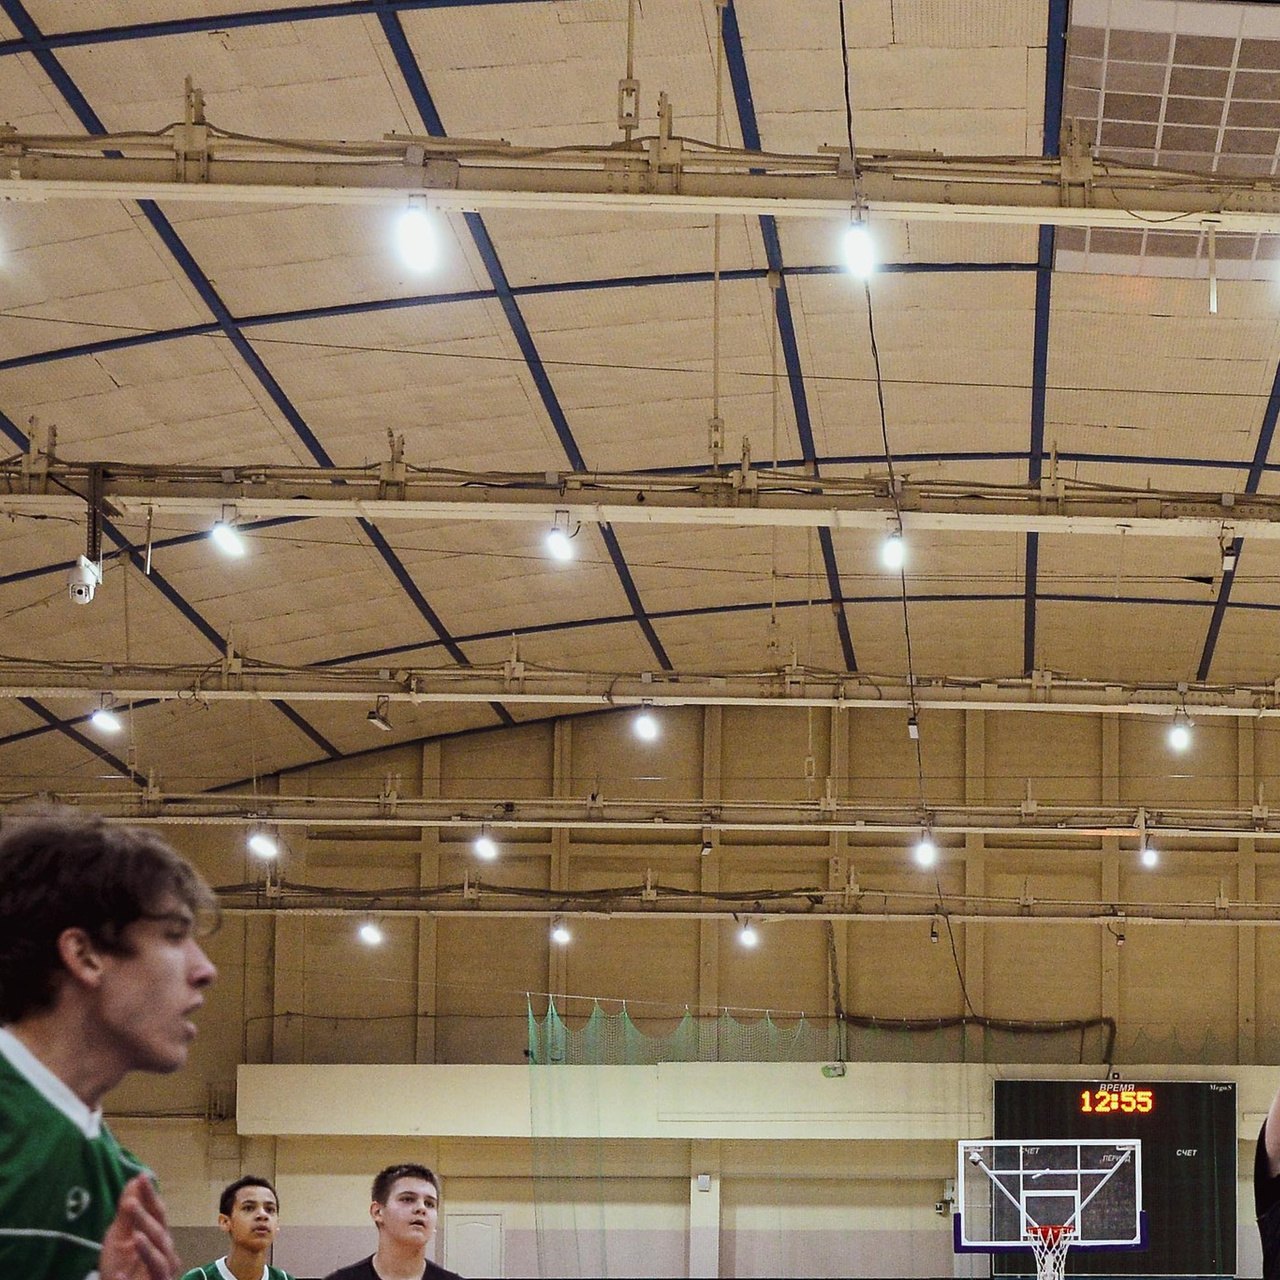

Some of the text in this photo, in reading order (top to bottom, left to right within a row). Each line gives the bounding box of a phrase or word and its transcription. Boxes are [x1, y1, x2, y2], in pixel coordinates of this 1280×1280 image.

[1099, 1083, 1135, 1092] ВРЕМЯ
[1081, 1090, 1153, 1112] 12:55
[1176, 1149, 1198, 1157] СЧЕТ
[1102, 1154, 1131, 1163] ПЕРИД
